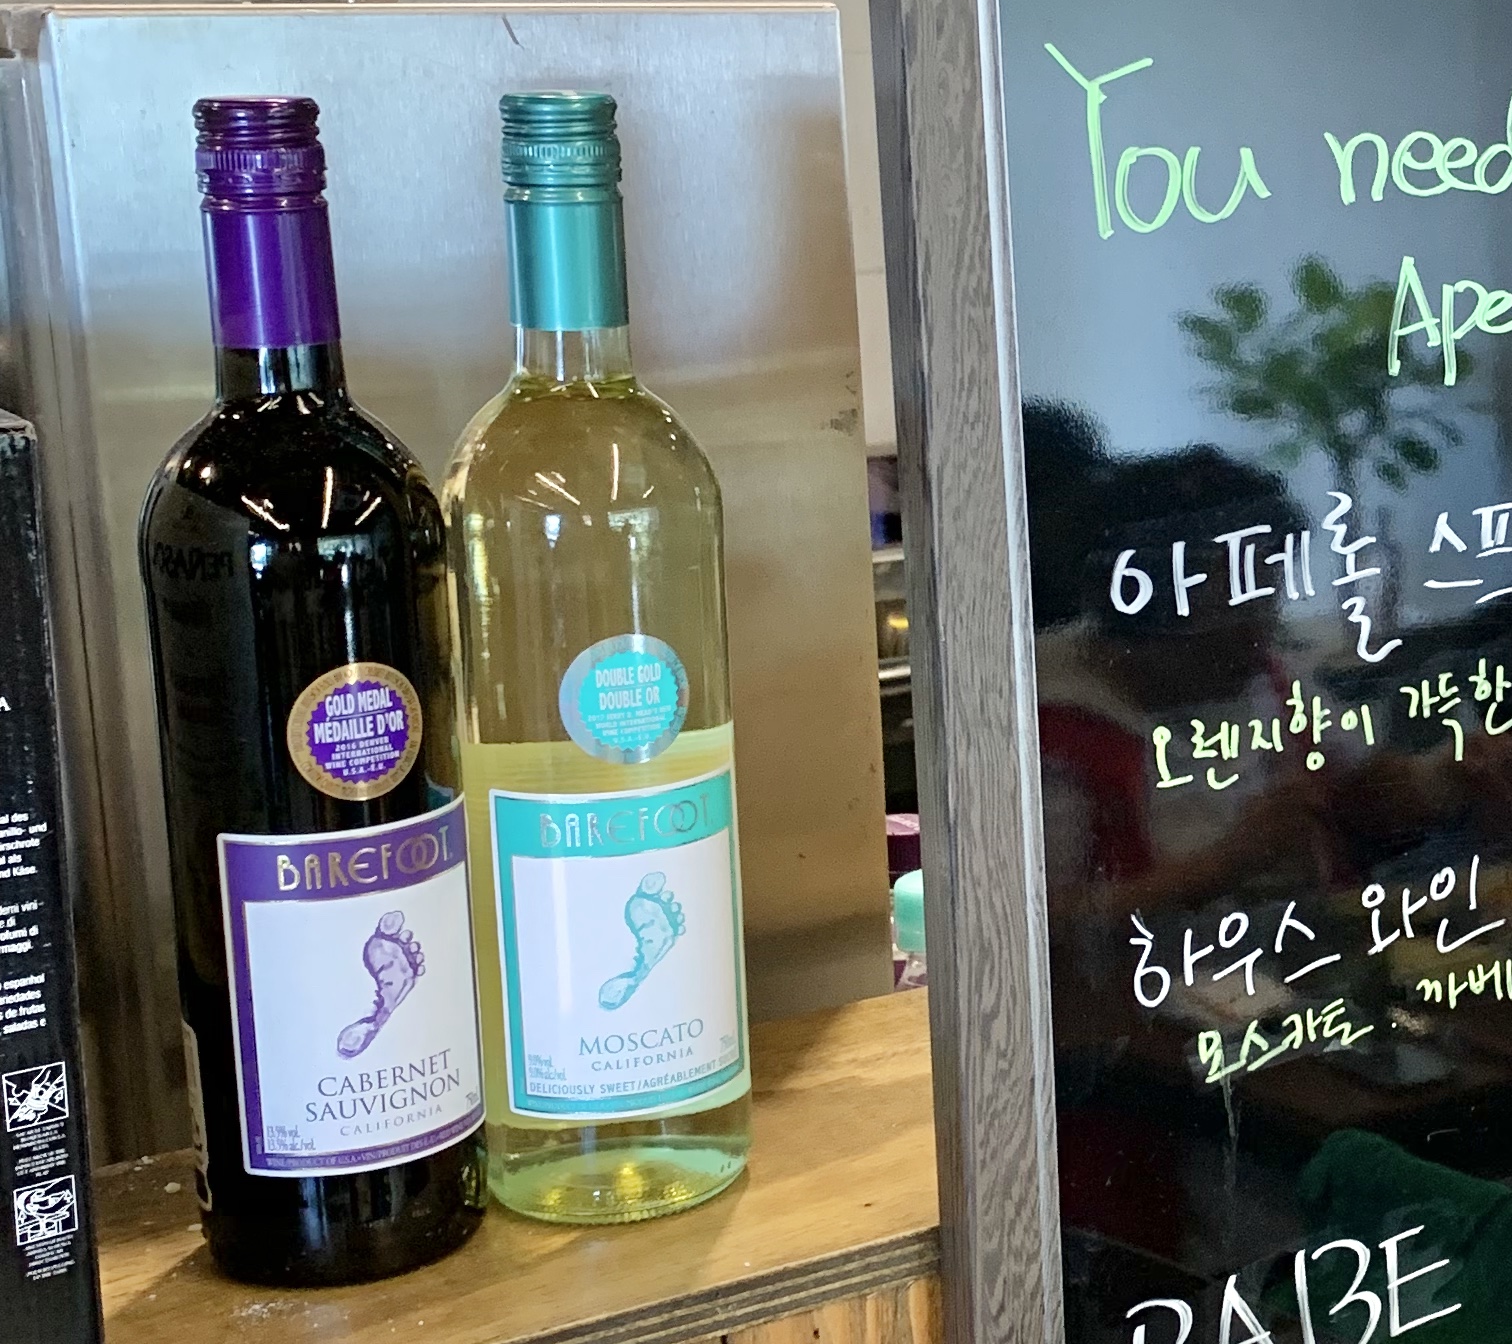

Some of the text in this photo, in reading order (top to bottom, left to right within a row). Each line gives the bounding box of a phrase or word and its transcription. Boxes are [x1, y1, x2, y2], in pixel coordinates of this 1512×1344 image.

[1045, 41, 1271, 240] You
[1109, 490, 1402, 662] 아페롤
[595, 662, 662, 689] DOUBLE GOLD
[325, 686, 394, 718] GOLD MEDAL
[599, 685, 660, 711] DOUBLE OR
[313, 709, 405, 745] MÉDAILLE D'OR
[1153, 682, 1375, 790] 오렌지향이
[324, 749, 401, 771] WINE COMPETITION
[331, 743, 394, 761] INTERNATIONAL
[334, 735, 390, 753] 2016 DENVER
[11, 812, 30, 823] des
[28, 821, 48, 835] und
[540, 791, 708, 849] BAREFOOT
[276, 825, 450, 892] BAREFOOT
[1130, 856, 1507, 1009] 하우스 와인
[3, 972, 46, 990] espanhol
[3, 1019, 39, 1035] saladas
[5, 1008, 18, 1020] de
[19, 1003, 47, 1017] frutas
[578, 1017, 705, 1057] MOSCATO
[1198, 997, 1374, 1084] 모스카토
[317, 1047, 452, 1098] CABERNET
[591, 1046, 694, 1072] CALIFORNIA
[304, 1068, 461, 1123] SAUVIGNON
[529, 1081, 595, 1095] DELICIOUSLY
[339, 1104, 444, 1137] CALIFORNIA
